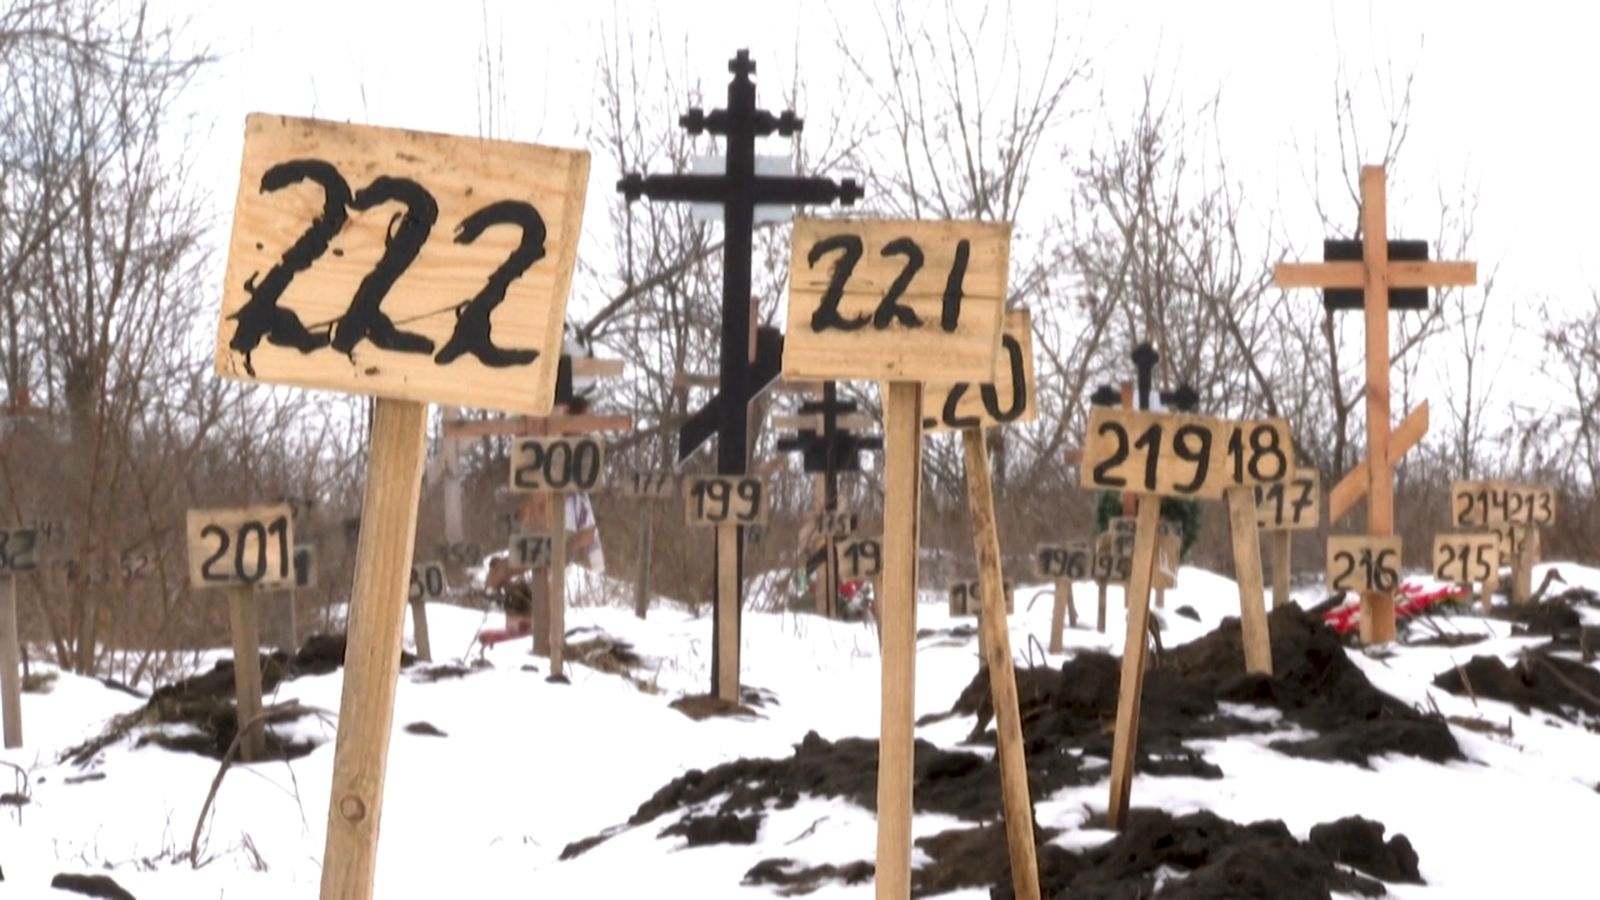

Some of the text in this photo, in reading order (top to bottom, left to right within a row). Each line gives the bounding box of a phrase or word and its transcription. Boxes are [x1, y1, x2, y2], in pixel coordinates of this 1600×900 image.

[229, 158, 547, 370] 222
[807, 234, 970, 333] 221
[922, 333, 1027, 428] 20
[514, 439, 600, 490] 200
[1092, 421, 1213, 493] 219
[1227, 424, 1287, 483] 18
[690, 479, 762, 522] 199
[1457, 489, 1509, 526] 214
[1510, 492, 1552, 525] 213
[201, 515, 289, 583] 201
[843, 540, 881, 577] 19
[1039, 549, 1086, 579] 196
[1333, 549, 1399, 594] 216
[1437, 543, 1494, 583] 215
